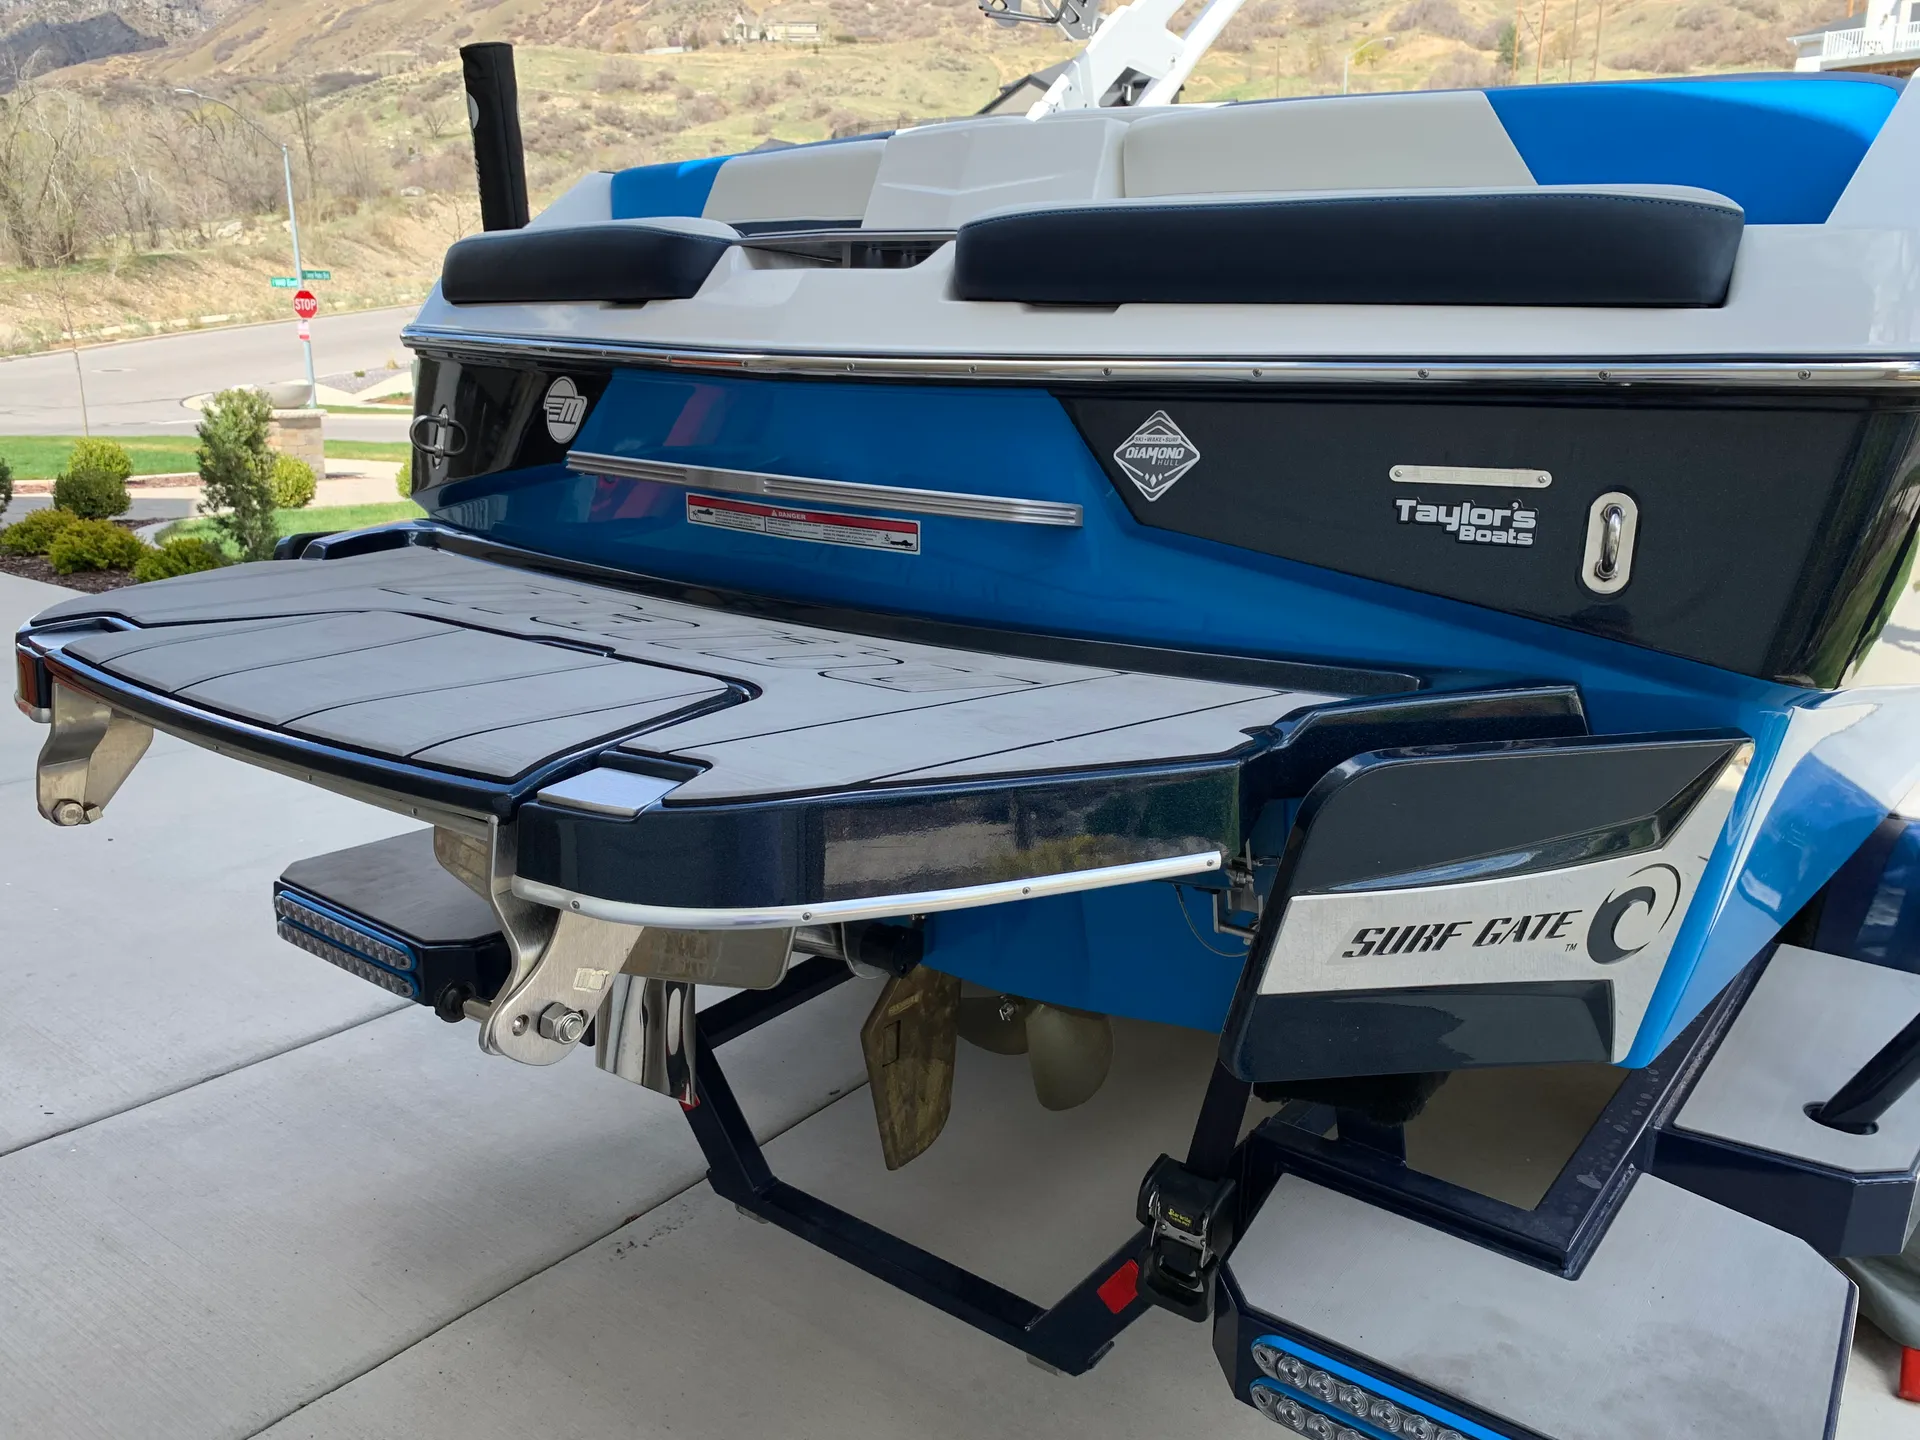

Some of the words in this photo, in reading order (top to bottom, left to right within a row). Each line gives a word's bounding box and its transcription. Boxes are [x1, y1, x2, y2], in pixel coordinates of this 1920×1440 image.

[295, 299, 317, 311] STOP
[778, 511, 806, 520] DANGER
[1396, 499, 1536, 531] Taylor's
[1459, 526, 1533, 545] Boats
[1342, 920, 1473, 958] SURF
[1472, 909, 1583, 947] GATE
